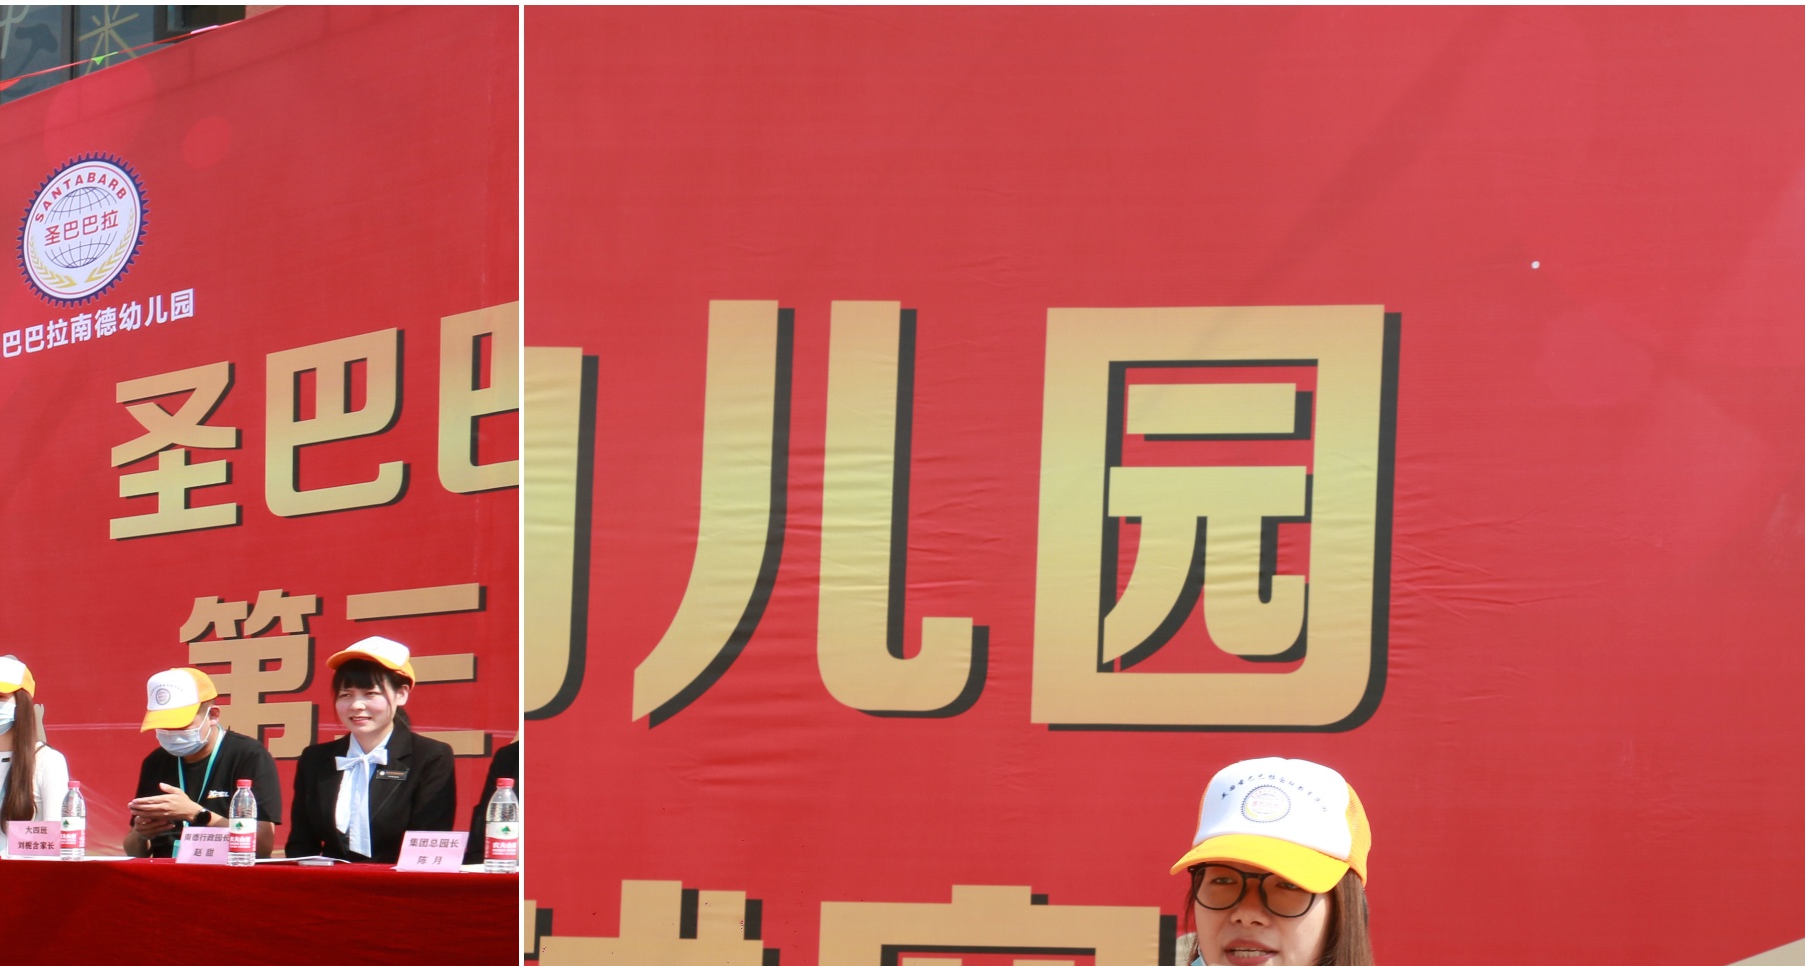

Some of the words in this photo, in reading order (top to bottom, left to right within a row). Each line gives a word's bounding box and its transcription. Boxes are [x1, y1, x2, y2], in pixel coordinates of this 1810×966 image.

[35, 172, 127, 223] SANTABARB
[44, 209, 119, 246] 圣巴巴拉
[25, 826, 48, 835] 大四班
[184, 833, 231, 843] 南德行政园长
[409, 837, 460, 848] 集团总园长
